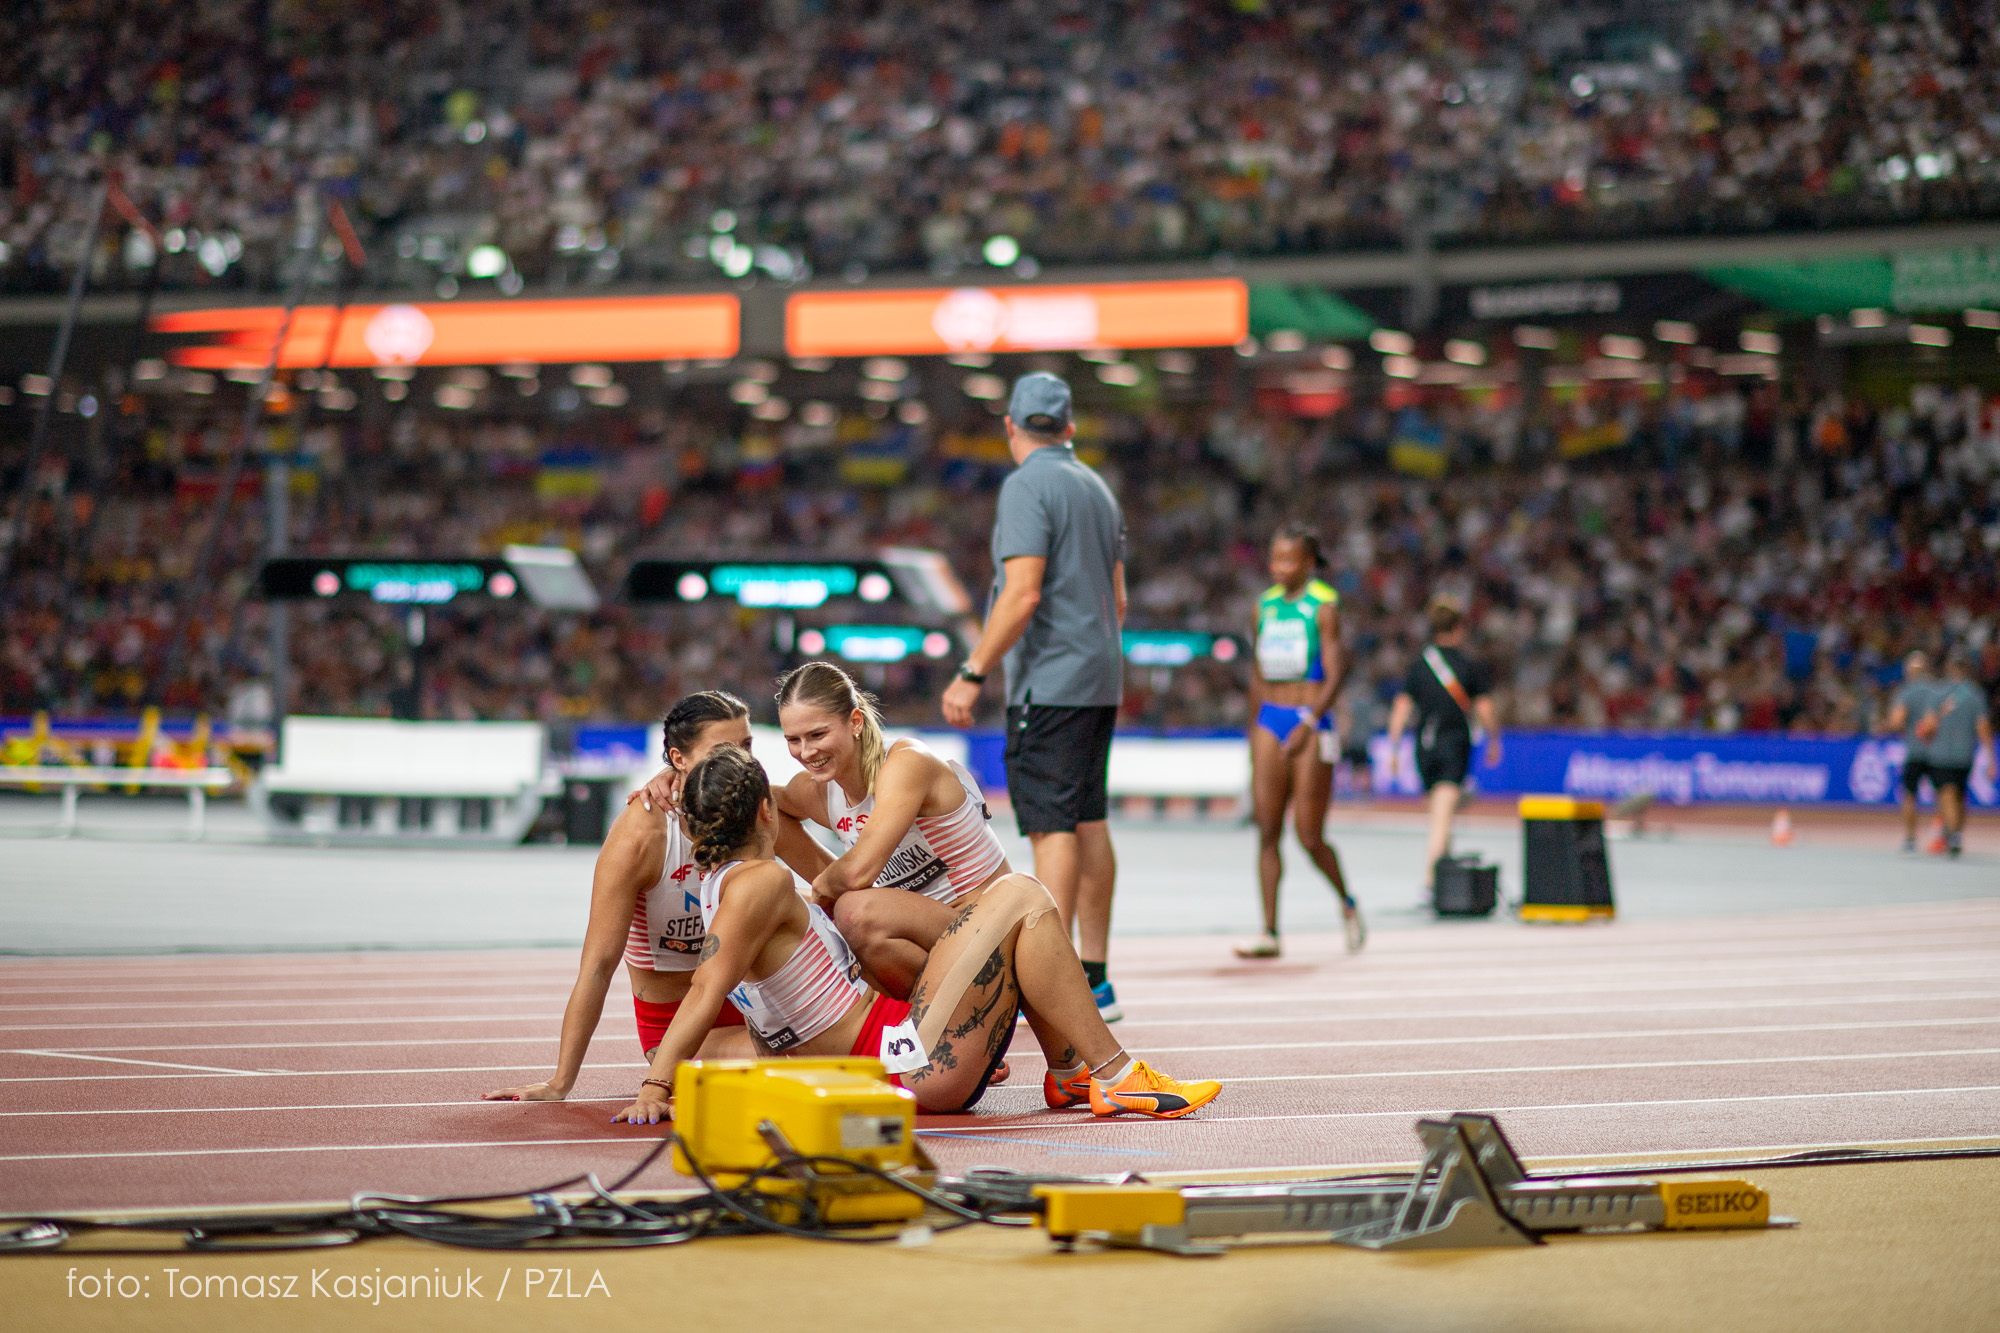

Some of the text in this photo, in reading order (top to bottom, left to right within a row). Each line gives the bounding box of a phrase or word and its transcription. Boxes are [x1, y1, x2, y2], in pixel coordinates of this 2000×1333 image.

[670, 864, 694, 881] 4F
[926, 865, 940, 877] 23
[1676, 1190, 1759, 1215] SEIKO
